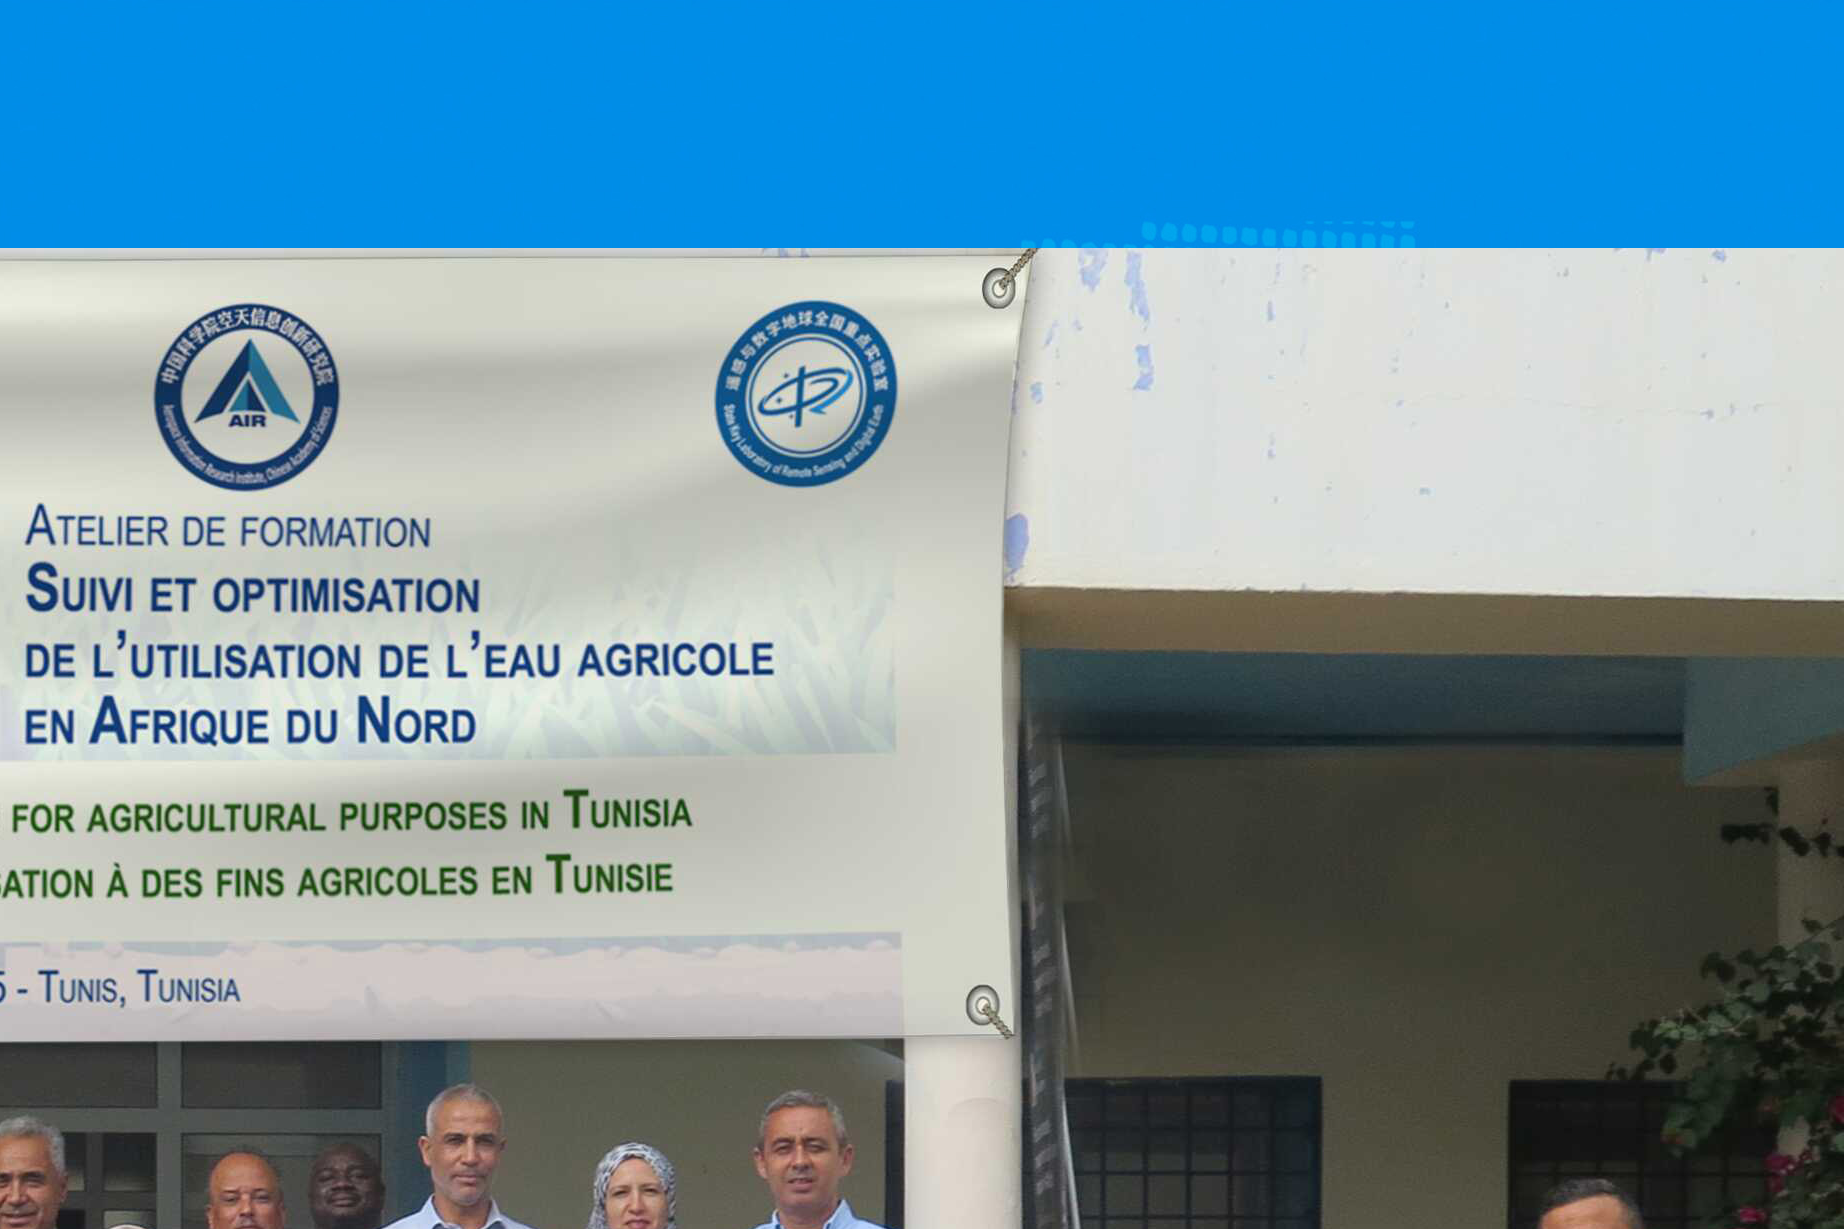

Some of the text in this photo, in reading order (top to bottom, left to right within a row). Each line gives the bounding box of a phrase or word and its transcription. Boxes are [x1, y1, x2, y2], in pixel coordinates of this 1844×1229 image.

[229, 415, 266, 428] AIR
[25, 503, 430, 548] ATELIER DE FORMATION
[26, 561, 479, 613] SUIVI ET OPTIMISATION
[26, 644, 75, 678] DE
[380, 644, 429, 678] DE
[577, 642, 774, 677] AGRICOLE
[25, 695, 476, 746] EN AFRIQUE DU NORD
[12, 804, 75, 833] FOR
[87, 803, 326, 833] AGRICULTURAL
[340, 802, 507, 831] PURPOSES
[522, 801, 548, 829] IN
[563, 789, 692, 828] TUNISIA
[106, 862, 128, 898] À
[142, 868, 202, 898] DES
[217, 868, 284, 897] FINS
[297, 866, 478, 896] AGRICOLES
[492, 866, 532, 895] EN
[546, 854, 673, 894] TUNISIE
[38, 970, 125, 1008] TUNIS,
[137, 969, 240, 1002] TUNISIA
